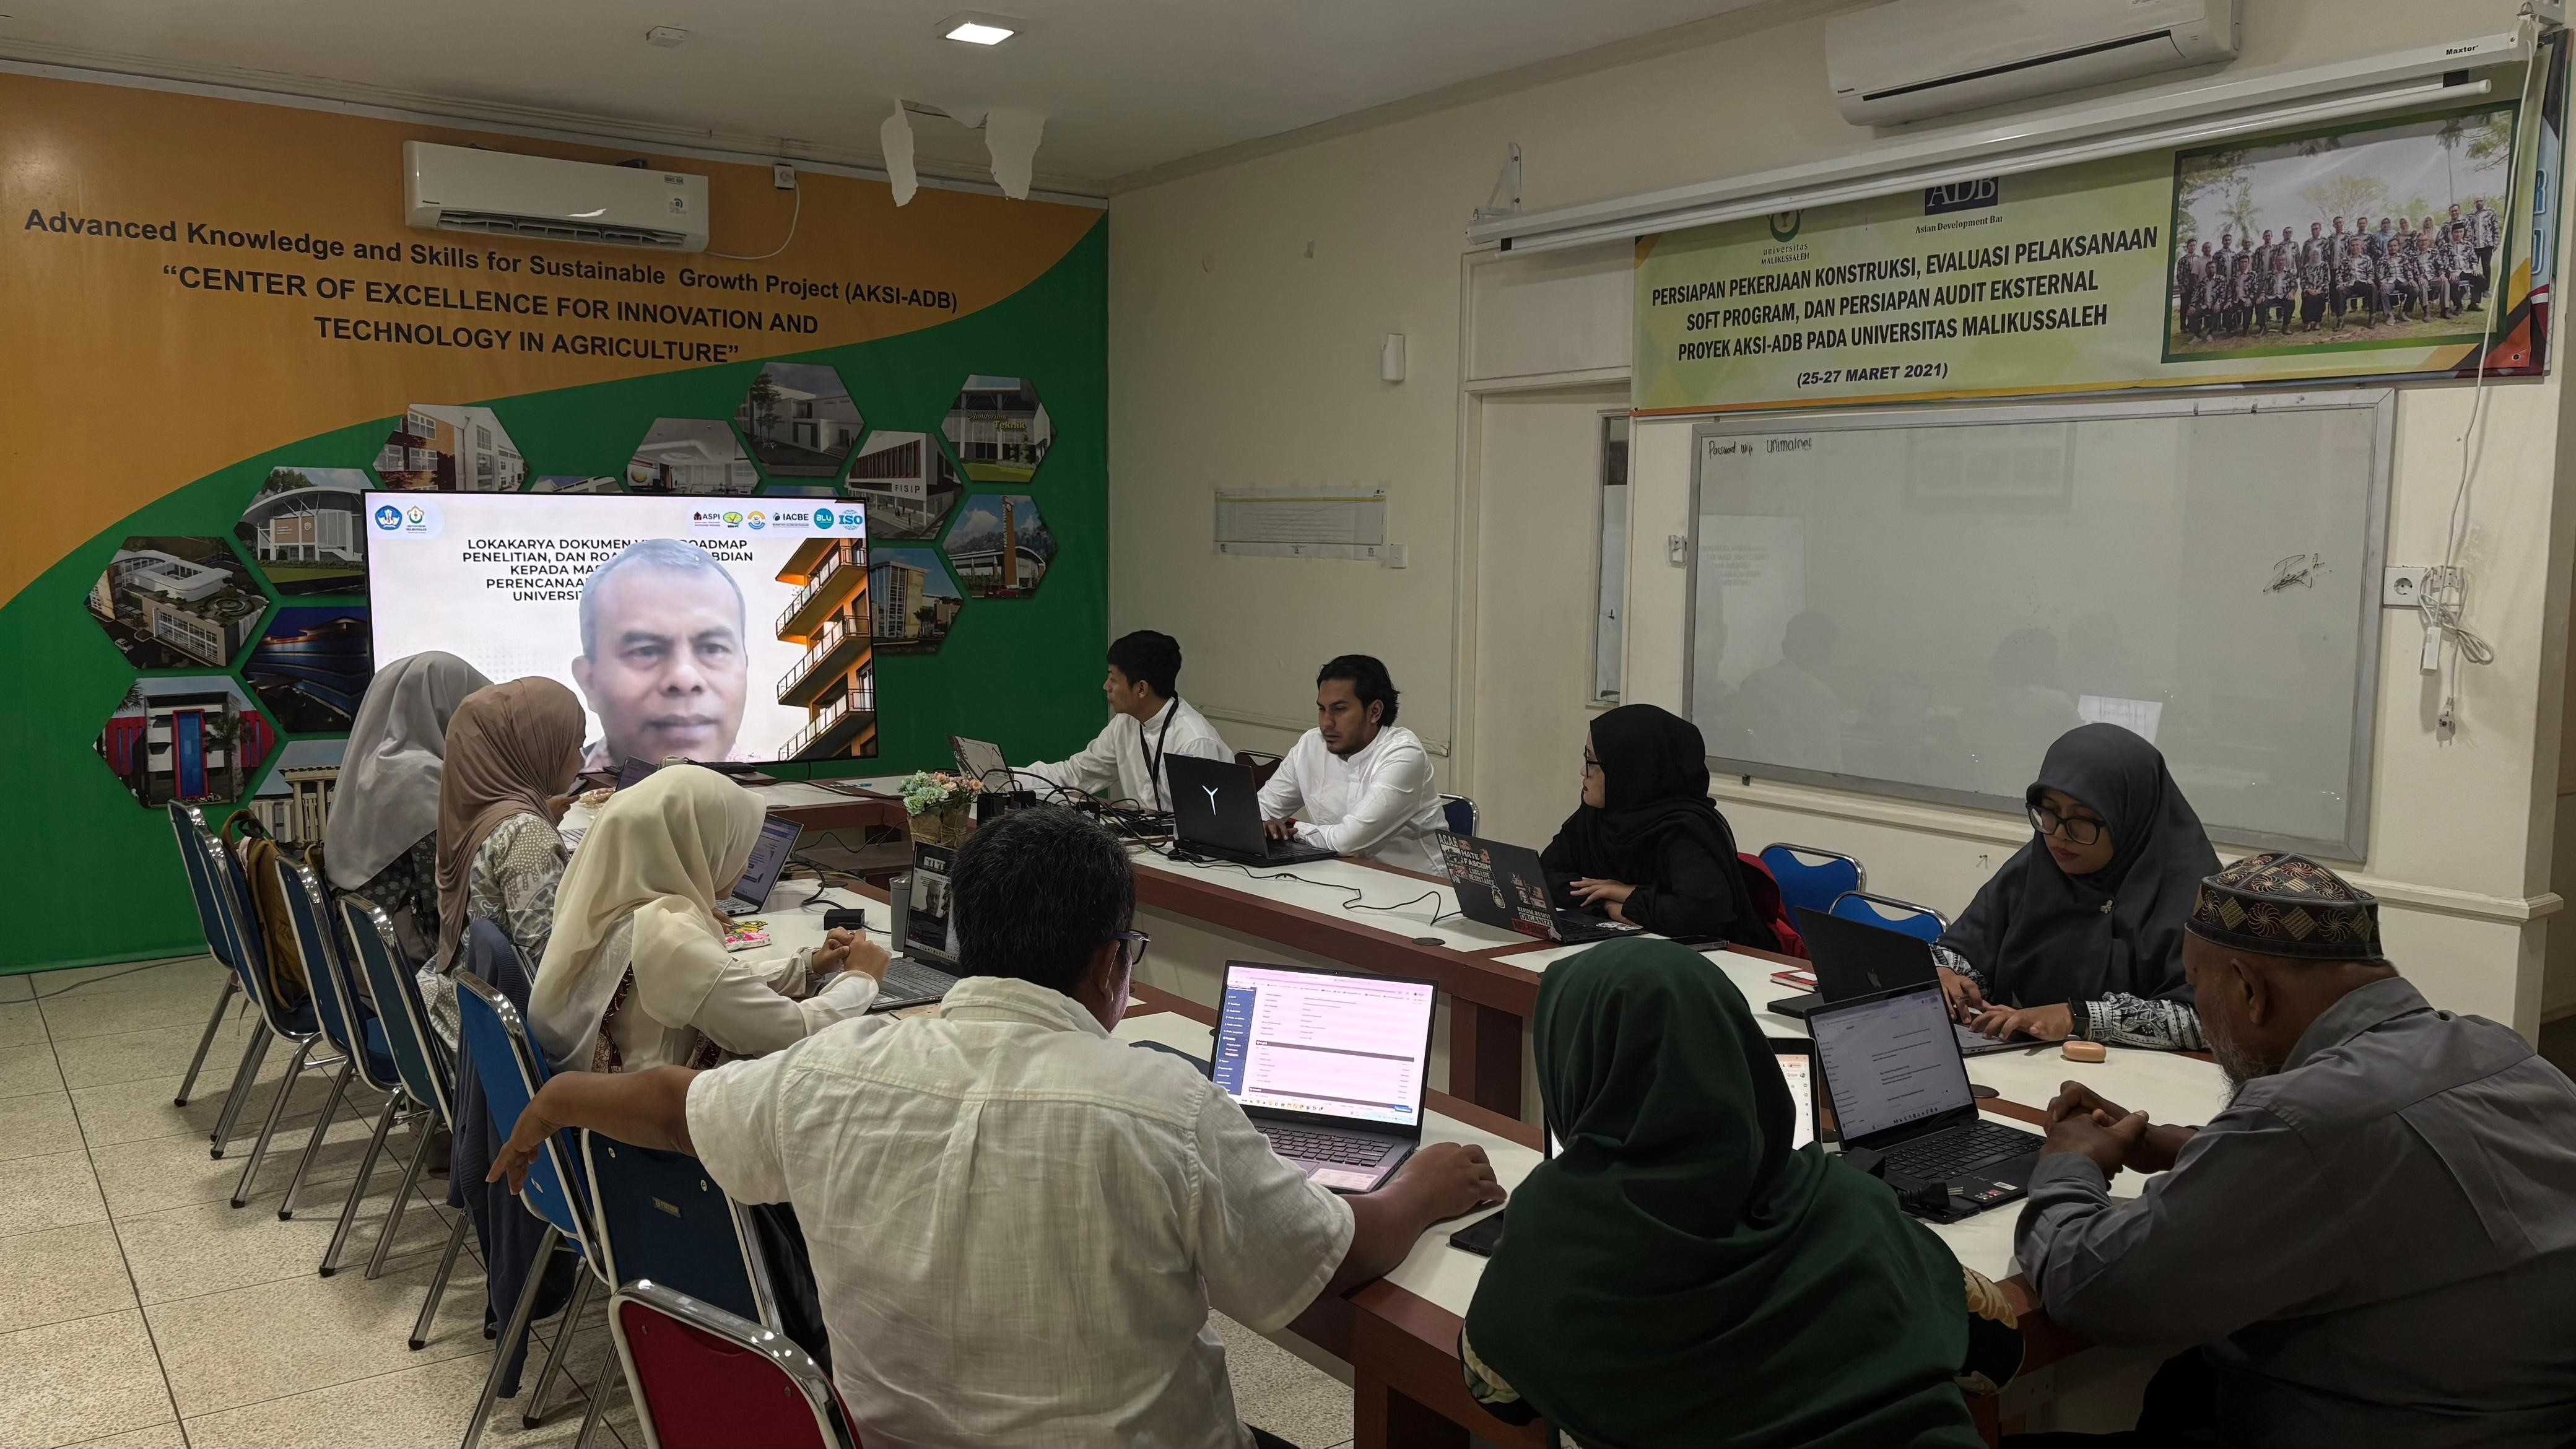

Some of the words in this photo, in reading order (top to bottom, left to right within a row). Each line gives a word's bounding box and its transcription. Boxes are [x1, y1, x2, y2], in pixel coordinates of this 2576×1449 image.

[2445, 46, 2476, 55] Maxtor
[1926, 176, 1996, 207] ADB
[1915, 225, 1936, 234] Asian
[1937, 217, 1988, 230] Development
[1763, 243, 1808, 255] universitas
[25, 209, 176, 242] Advanced
[188, 222, 344, 260] Knowledge
[354, 242, 401, 261] and
[411, 244, 479, 269] Skills
[485, 251, 521, 272] for
[530, 255, 665, 284] Sustainable
[679, 268, 757, 292] Growth
[766, 275, 838, 300] Project
[845, 282, 957, 314] (AKSI-ADB)
[1653, 281, 1725, 306] PERSIAPAN
[1730, 270, 1811, 297] PEKERJAAN
[1816, 257, 1920, 287] KONSTRUKSI,
[1926, 245, 2009, 274] EVALUASI
[2015, 226, 2157, 264] PELAKSANAAN
[1760, 253, 1809, 265] MALIKUSSALEH
[163, 265, 307, 297] “CENTER
[316, 277, 355, 300] OF
[366, 281, 548, 315] EXCELLENCE
[557, 297, 609, 320] FOR
[618, 302, 762, 330] INNOVATION
[768, 313, 817, 333] AND
[1687, 311, 1720, 331] SOFT
[1723, 303, 1799, 327] PROGRAM,
[1804, 298, 1835, 319] DAN
[1840, 288, 1930, 315] PERSIAPAN
[1933, 282, 1986, 306] AUDIT
[1991, 270, 2098, 300] EKSTERNAL
[314, 316, 511, 350] TECHNOLOGY
[520, 332, 543, 352] IN
[552, 334, 738, 362] AGRICULTURE”
[1679, 339, 1730, 361] PROYEK
[1733, 333, 1802, 356] AKSI-ADB
[1807, 329, 1847, 349] PADA
[1852, 318, 1957, 346] UNIVERSITAS
[1962, 304, 2107, 337] MALIKUSSALEH
[1798, 370, 1842, 388] (25-27
[1846, 366, 1900, 381] MARET
[1904, 363, 1947, 379] 2021)
[895, 484, 921, 494] FISIP
[838, 515, 863, 525] ISO
[468, 539, 555, 549] LOKAKARYA
[560, 539, 631, 549] DOKUMEN
[463, 552, 551, 564] PENELITIAN,
[556, 552, 586, 562] DAN
[510, 565, 570, 575] KEPADA
[486, 578, 588, 589] PERENCANAA
